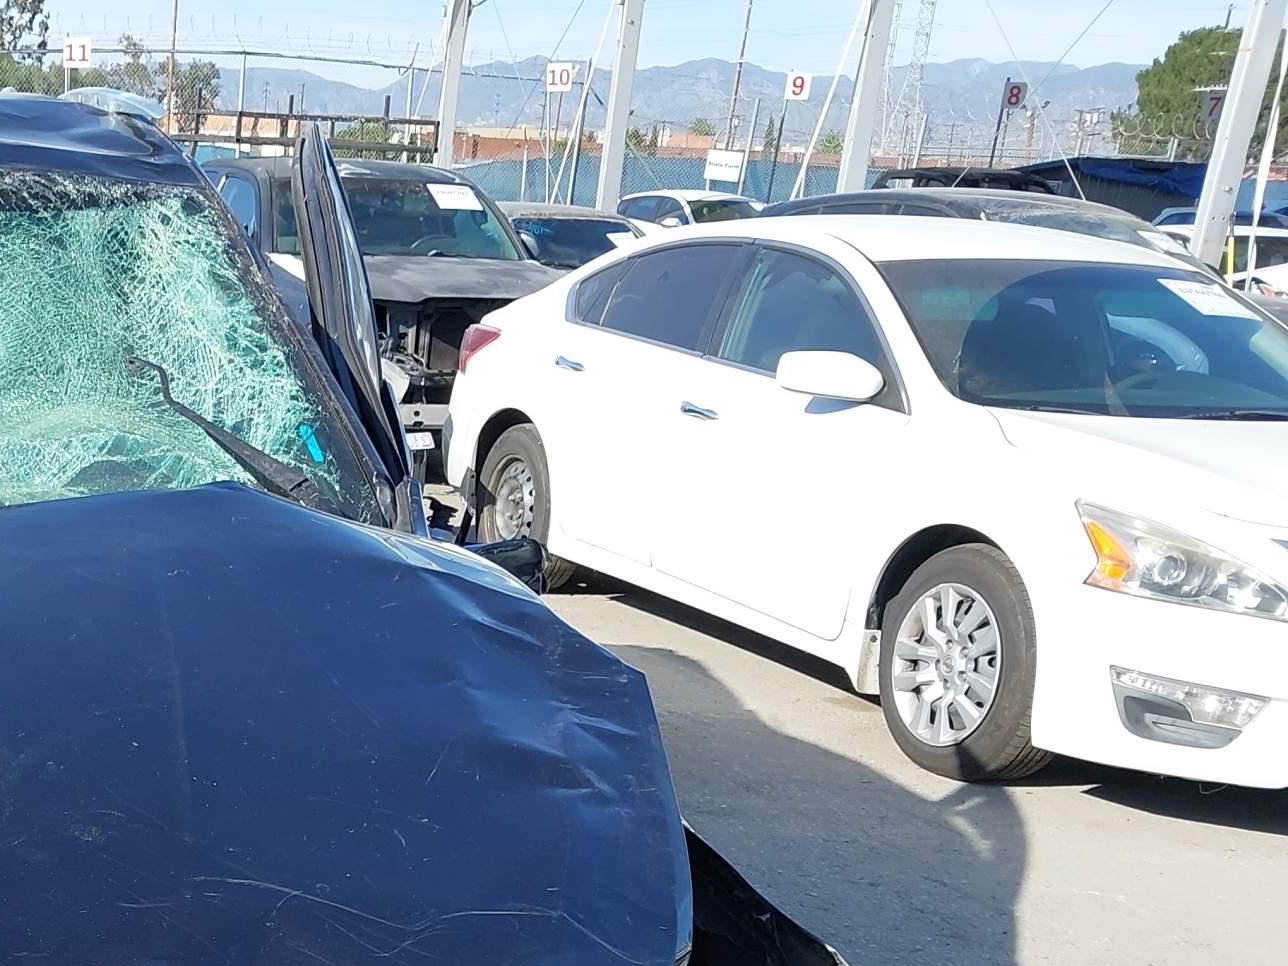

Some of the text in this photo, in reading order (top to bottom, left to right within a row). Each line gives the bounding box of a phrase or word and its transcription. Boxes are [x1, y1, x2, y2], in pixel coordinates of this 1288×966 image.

[65, 44, 89, 62] 11
[548, 69, 570, 86] 10
[792, 76, 805, 96] 9
[1008, 85, 1021, 106] 8
[1208, 96, 1222, 118] 7
